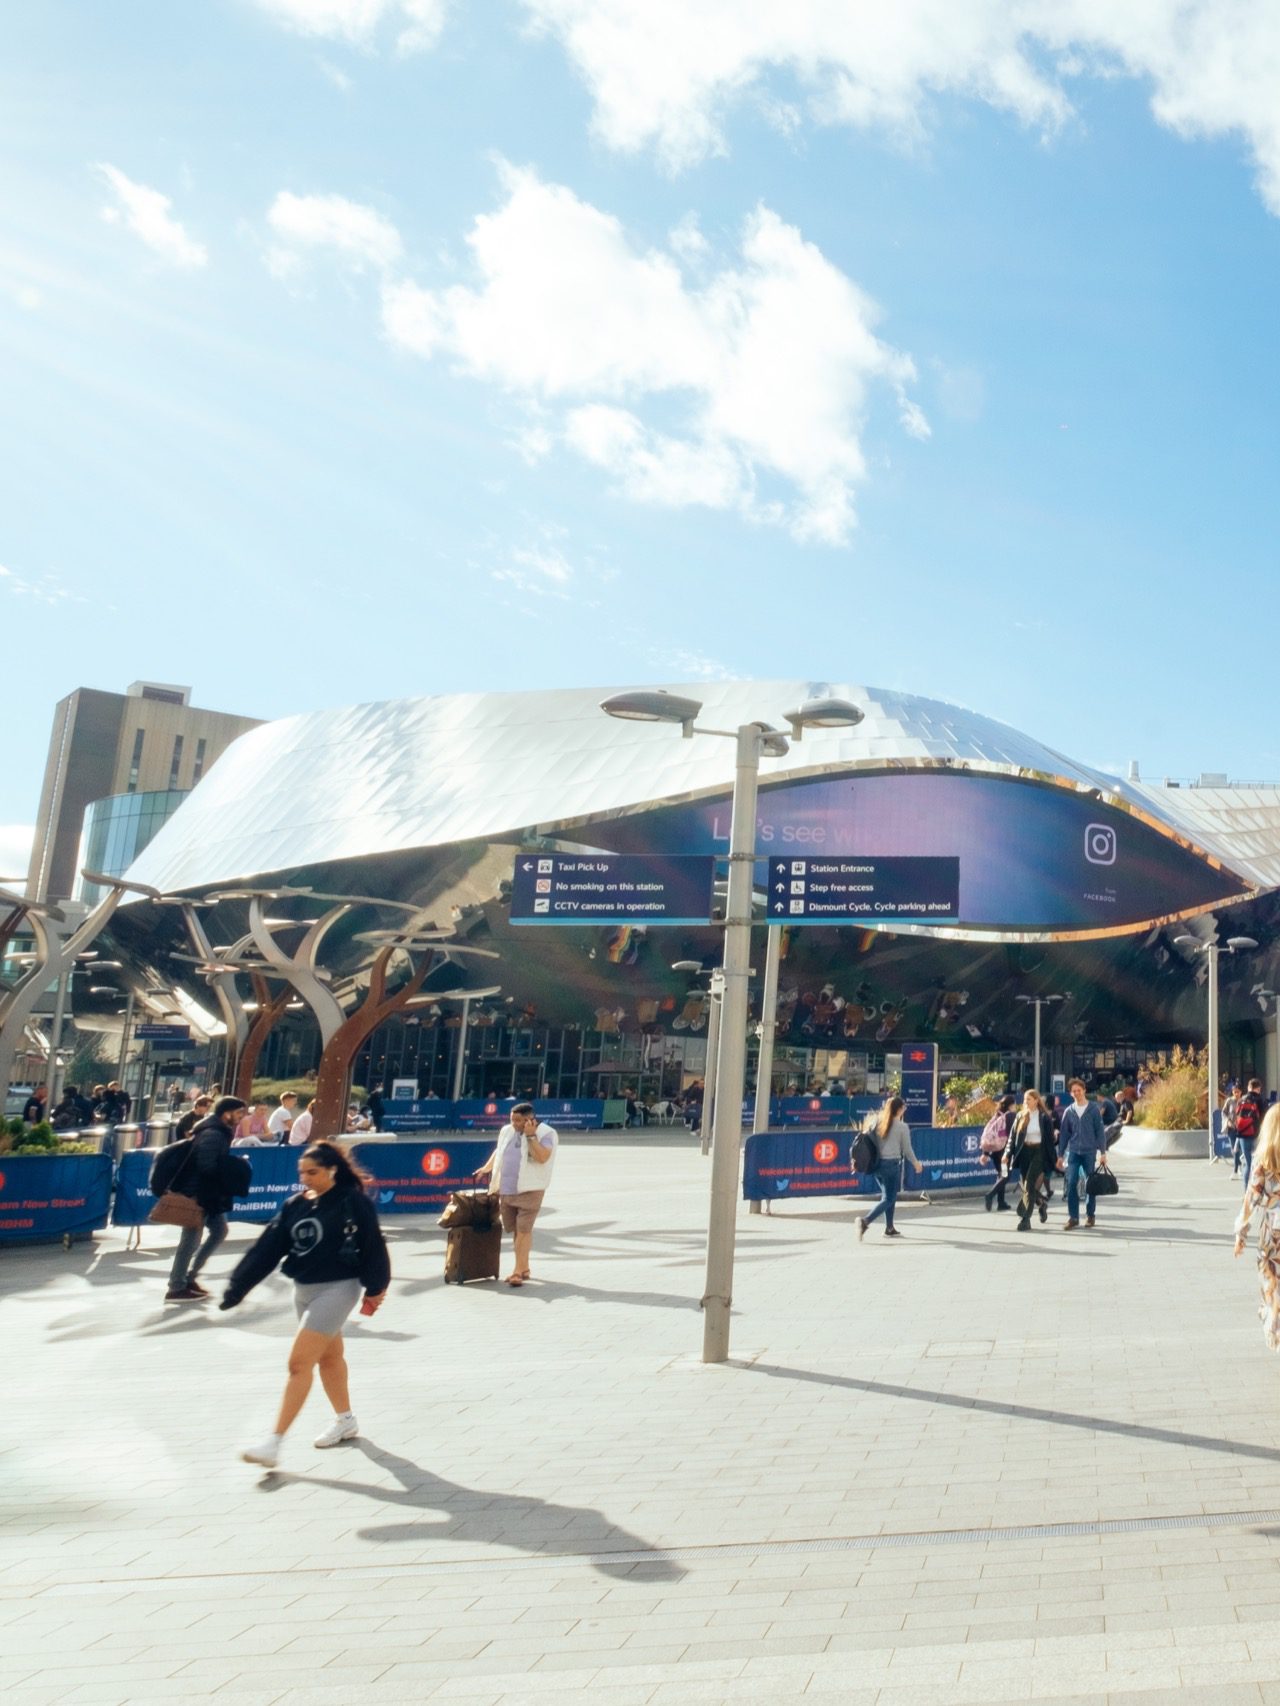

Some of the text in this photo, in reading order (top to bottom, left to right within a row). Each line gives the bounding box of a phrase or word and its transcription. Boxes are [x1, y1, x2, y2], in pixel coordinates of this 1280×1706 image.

[713, 817, 774, 842] L's
[782, 824, 827, 843] see
[558, 863, 609, 872] Taxi Pick Up
[810, 864, 875, 873] Station Entrance
[556, 883, 569, 891] No
[570, 883, 605, 893] smoking
[619, 883, 634, 891] this
[635, 883, 664, 891] station
[809, 883, 829, 893] Step
[830, 883, 847, 892] free
[554, 902, 666, 912] CCTV cameras in operation
[809, 903, 846, 911] Dismount
[874, 903, 896, 912] Cycle
[897, 903, 927, 913] parking
[928, 903, 951, 911] ahead
[267, 1184, 289, 1193] New
[23, 1200, 49, 1209] New
[51, 1198, 86, 1208] Street
